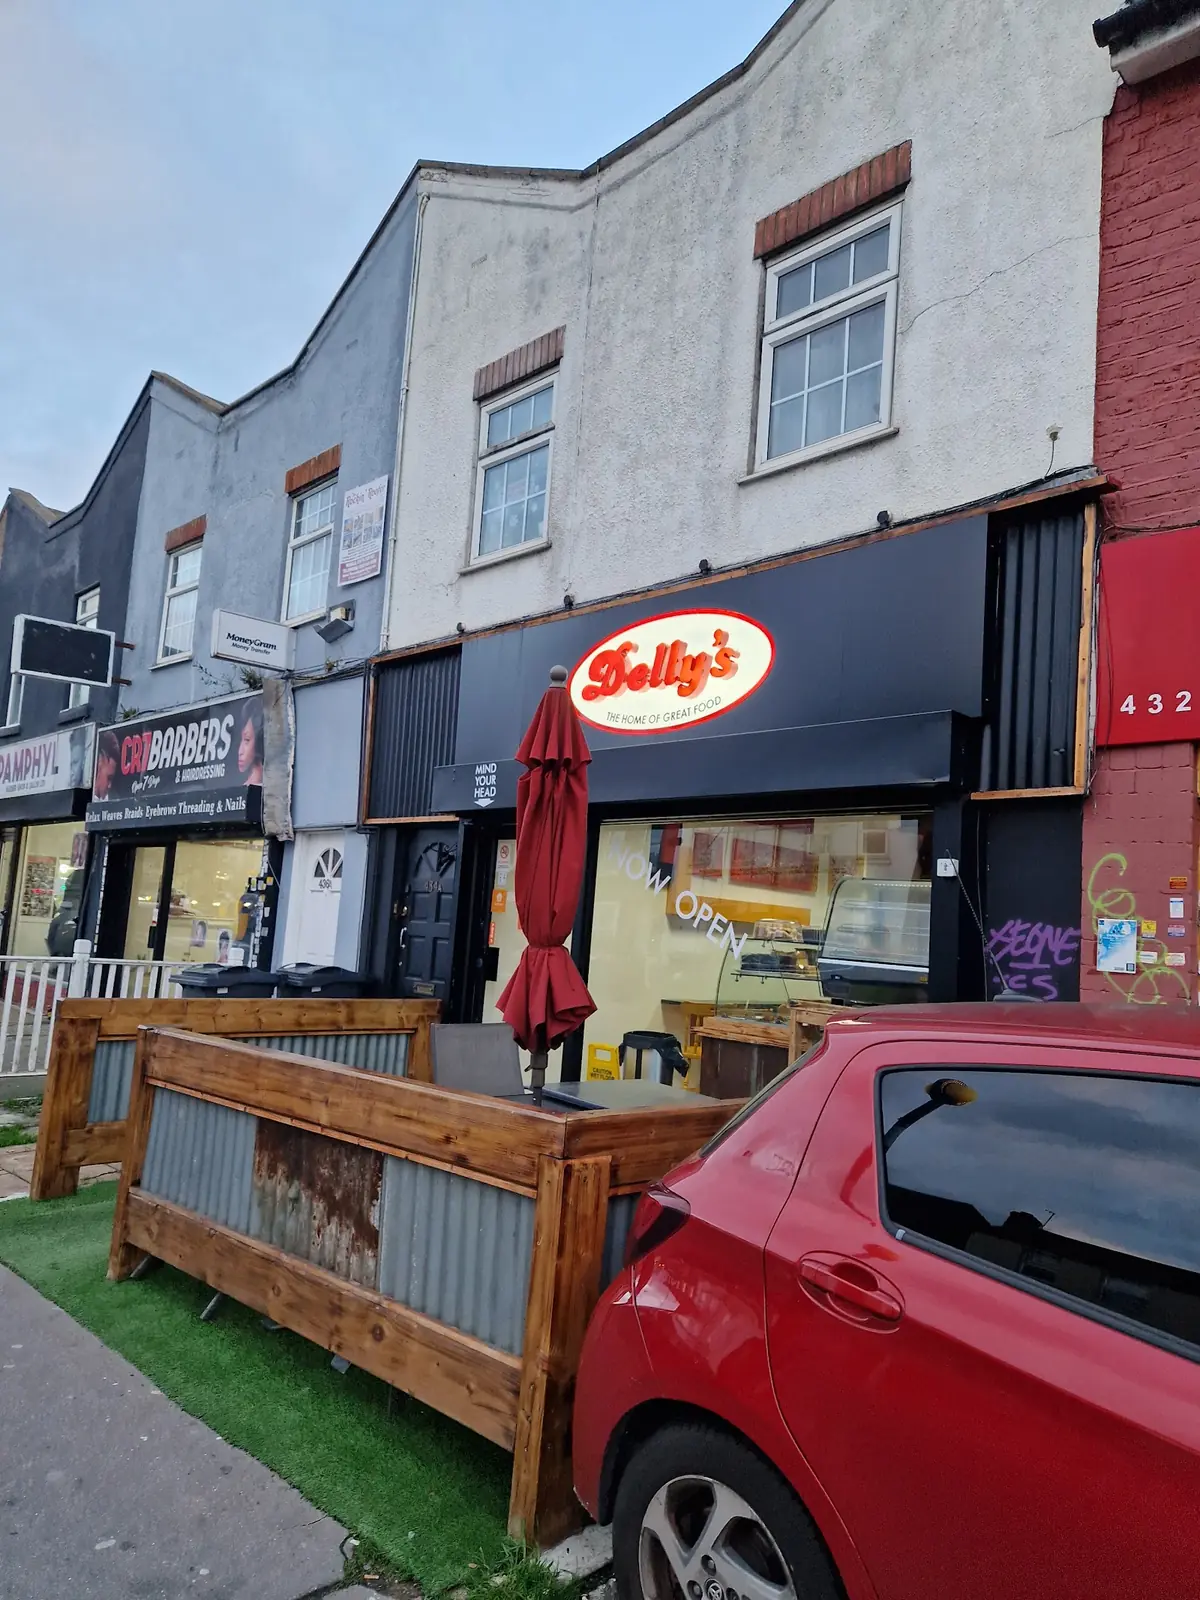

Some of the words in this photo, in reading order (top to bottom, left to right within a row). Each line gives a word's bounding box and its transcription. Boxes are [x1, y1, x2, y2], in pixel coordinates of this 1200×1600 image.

[226, 632, 278, 650] MoneyGram
[231, 642, 250, 652] Money
[250, 646, 271, 655] Transfer
[581, 628, 740, 702] Delly's
[606, 711, 621, 723] THE
[621, 714, 647, 725] HOME
[648, 714, 661, 724] OF
[662, 707, 692, 722] GREAT
[693, 695, 722, 715] FOOD
[181, 763, 226, 782] HAIRDRESSING
[475, 762, 497, 775] MIND
[475, 774, 497, 786] YOUR
[474, 786, 497, 798] HEAD
[101, 809, 123, 821] Weaves
[124, 805, 144, 819] Braids
[145, 803, 177, 819] Eyebrows
[178, 799, 215, 816] Threading
[216, 800, 223, 813] &
[224, 796, 247, 811] Nails
[608, 836, 672, 896] NOW
[675, 890, 749, 961] OPEN
